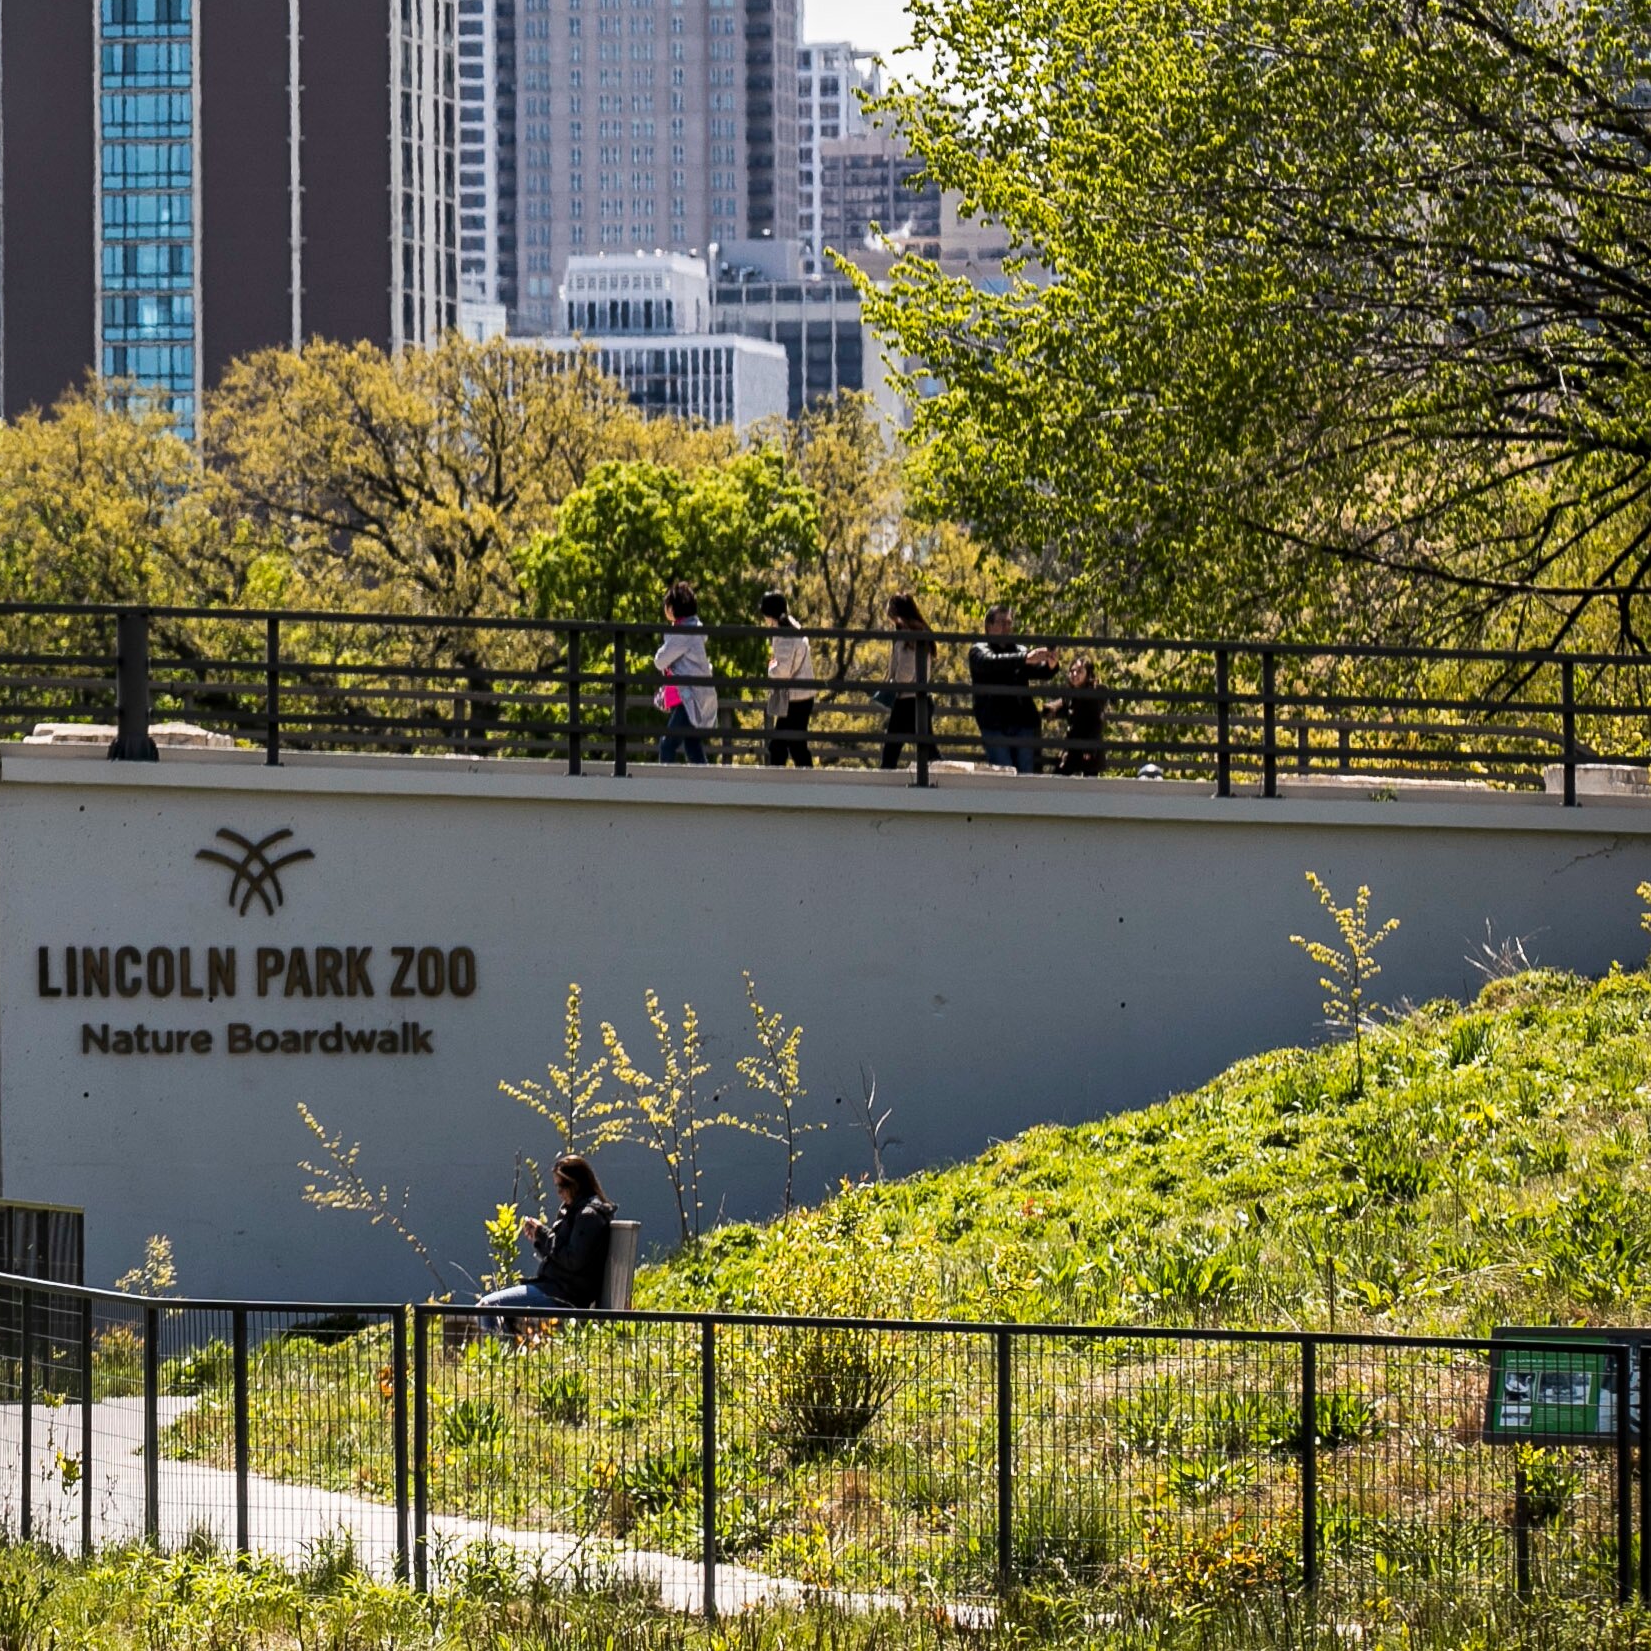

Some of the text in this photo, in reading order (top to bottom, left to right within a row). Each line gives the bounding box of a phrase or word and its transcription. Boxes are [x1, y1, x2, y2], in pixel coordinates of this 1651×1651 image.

[37, 945, 479, 999] LINCOLN PARK ZOO
[81, 1021, 435, 1055] Nature Boardwalk
